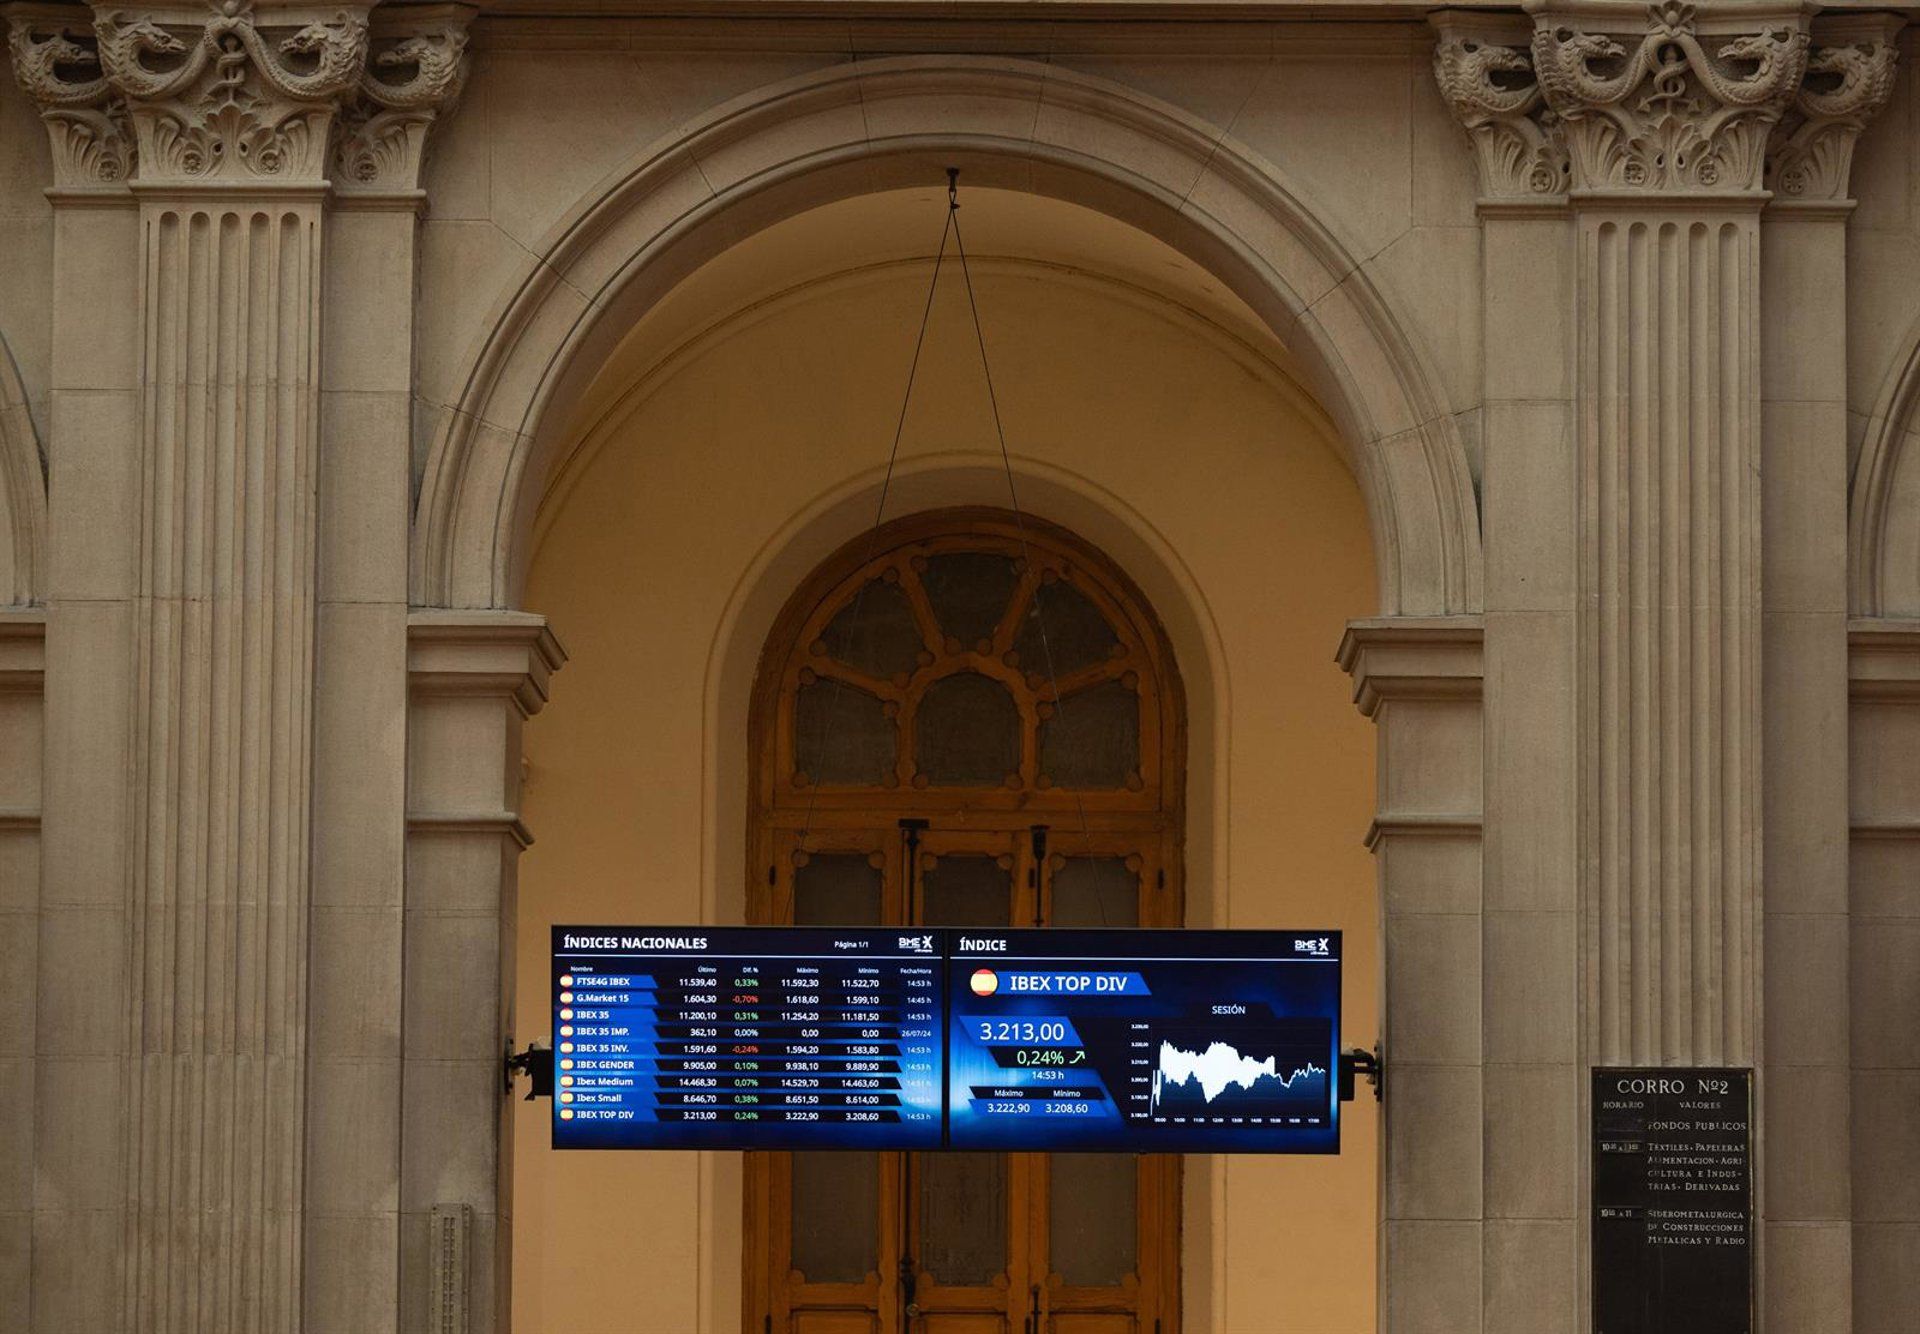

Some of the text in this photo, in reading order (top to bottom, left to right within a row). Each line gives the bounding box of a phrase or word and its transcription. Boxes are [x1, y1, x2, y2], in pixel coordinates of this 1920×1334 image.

[564, 934, 707, 949] ÍNDICES NACIONALES
[835, 941, 857, 949] Página
[899, 938, 920, 947] BME
[960, 937, 1006, 950] ÍNDICE
[680, 979, 716, 987] 11.539,40
[782, 979, 819, 987] 11.592,30
[1011, 976, 1127, 991] IBEX TOP DIV
[577, 994, 629, 1002] G.Market 15
[684, 995, 717, 1003] 1.604,30
[787, 996, 819, 1004] 1.618,60
[847, 996, 879, 1004] 1.599,10
[1212, 1004, 1245, 1014] SESIÓN
[577, 1011, 609, 1019] IBEX 35
[680, 1012, 716, 1020] 11.200,10
[782, 1013, 819, 1021] 11.254,20
[842, 1013, 879, 1021] 11.181,50
[691, 1028, 716, 1037] 362,10
[802, 1029, 819, 1037] 0,00
[980, 1023, 1064, 1043] 3.213,00
[577, 1044, 597, 1052] IBEX
[787, 1046, 818, 1054] 1.594,20
[847, 1046, 879, 1054] 1.583,80
[1017, 1051, 1064, 1066] 0,24%
[599, 1061, 634, 1069] GENDER
[684, 1062, 716, 1070] 9.905,00
[846, 1063, 879, 1071] 9.889,90
[1032, 1071, 1064, 1079] 14:53 h
[577, 1077, 596, 1085] Ibex
[680, 1078, 716, 1086] 14.468,30
[782, 1079, 818, 1087] 14.529,70
[842, 1080, 879, 1088] 14.463,60
[1618, 1080, 1684, 1093] CORRO
[598, 1094, 621, 1102] Small
[684, 1095, 716, 1103] 8.646,70
[786, 1096, 818, 1104] 8.651,50
[846, 1096, 879, 1104] 8.614,00
[988, 1103, 1030, 1113] 3.222,90
[1046, 1104, 1088, 1113] 3.208,60
[684, 1112, 716, 1120] 3.213,00
[786, 1112, 818, 1120] 3.222,90
[846, 1113, 879, 1121] 3.208,60
